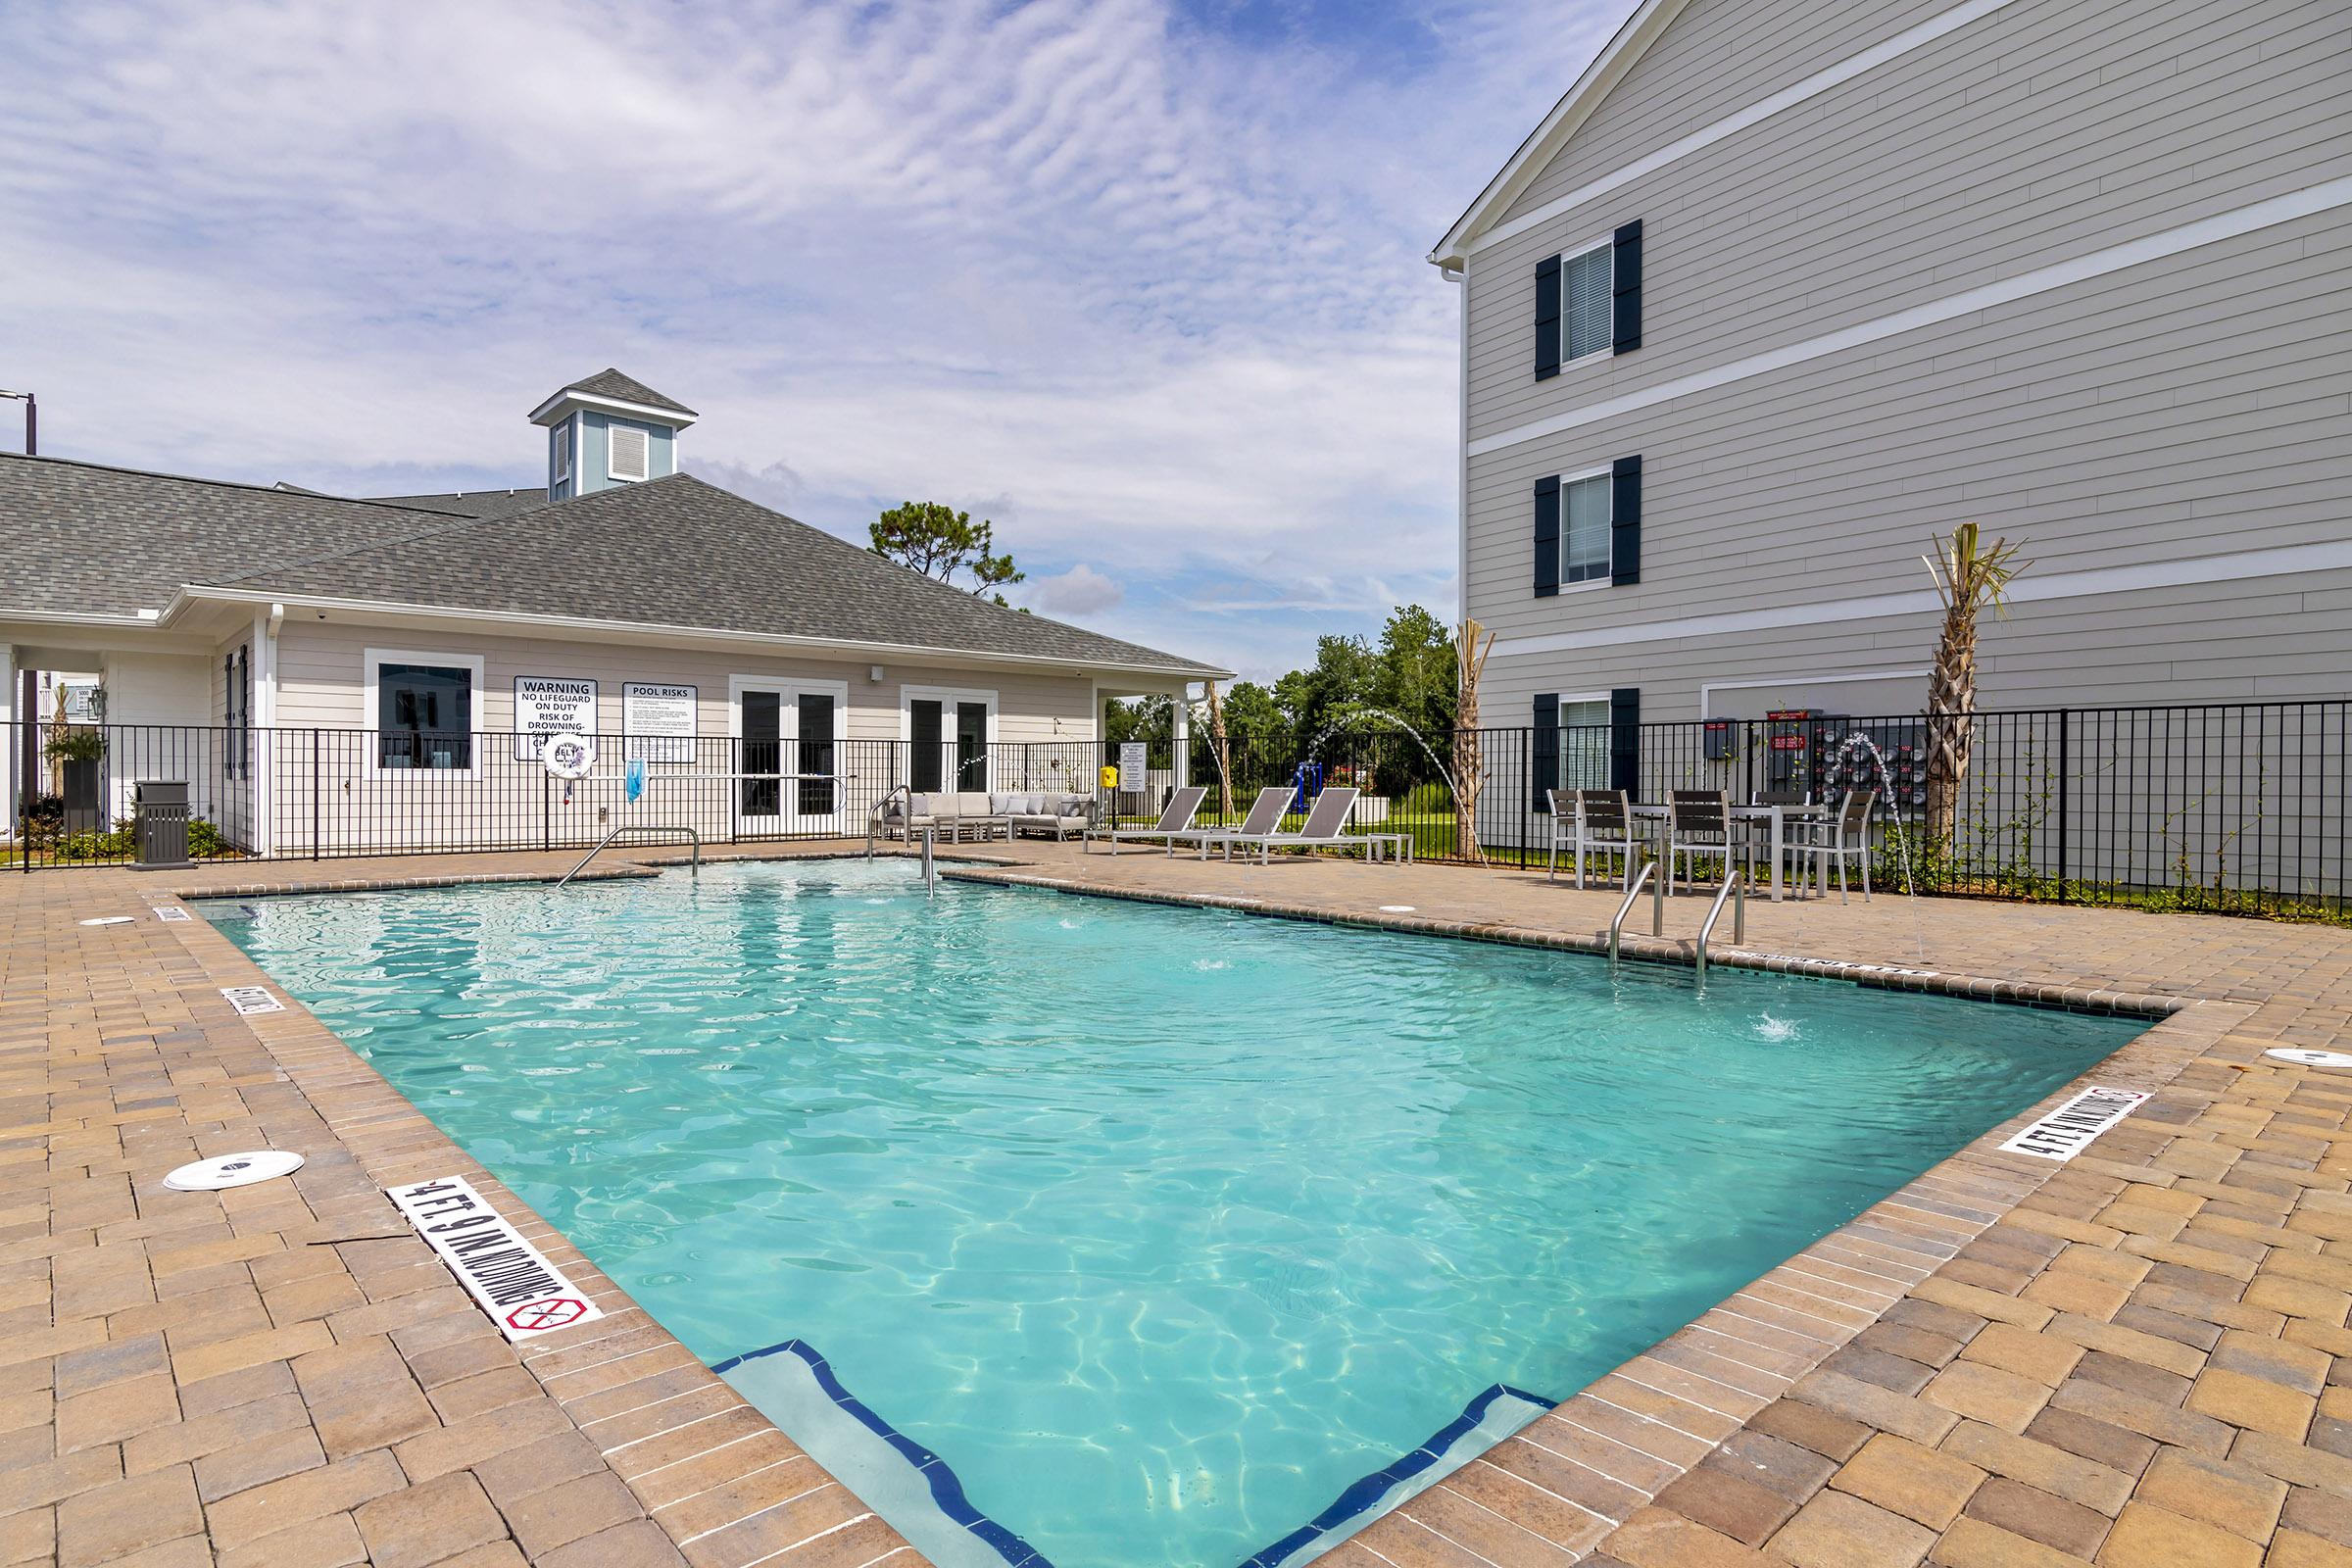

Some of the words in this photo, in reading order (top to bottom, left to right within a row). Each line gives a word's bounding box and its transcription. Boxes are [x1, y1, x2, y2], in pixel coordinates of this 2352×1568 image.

[523, 682, 589, 694] WARNING
[633, 687, 660, 696] POOL
[662, 689, 688, 698] RISKS
[539, 694, 591, 704] LIFEGUARD
[527, 721, 585, 731] DROWNING-
[2039, 1123, 2096, 1134] 9
[2016, 1143, 2065, 1154] 4
[405, 1184, 457, 1198] 4
[426, 1215, 497, 1233] 9
[460, 1247, 530, 1270] NO
[471, 1259, 564, 1307] DIVING
